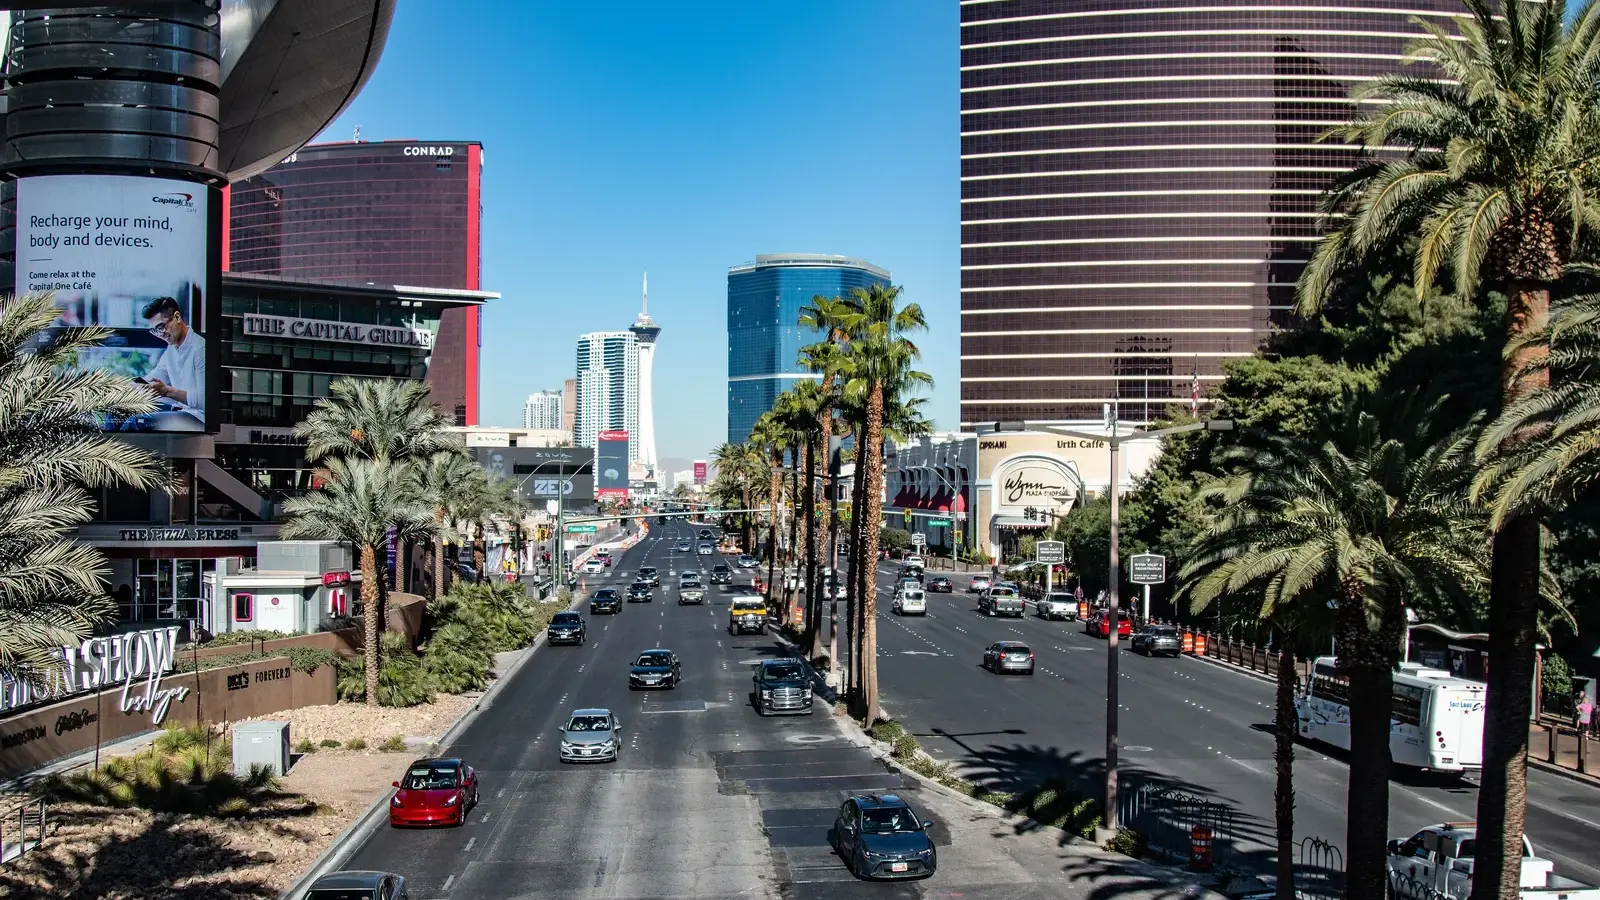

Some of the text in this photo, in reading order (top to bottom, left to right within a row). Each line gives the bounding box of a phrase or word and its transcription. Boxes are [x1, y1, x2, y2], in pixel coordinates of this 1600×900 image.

[404, 146, 453, 156] CONRAD
[30, 214, 173, 232] Recharge your mind,
[30, 233, 153, 249] body and devices.
[29, 270, 96, 279] Come relax at the
[29, 282, 54, 292] Capital
[72, 281, 92, 290] Café
[247, 316, 430, 347] THE CAPITAL GRILLE
[979, 440, 1007, 450] CIPRIANI
[1057, 440, 1076, 449] Urth
[1004, 471, 1062, 502] Wynn
[119, 529, 239, 541] THE PIZZA PRESS
[81, 626, 181, 690] SHOW
[255, 667, 291, 683] FOREVER 21
